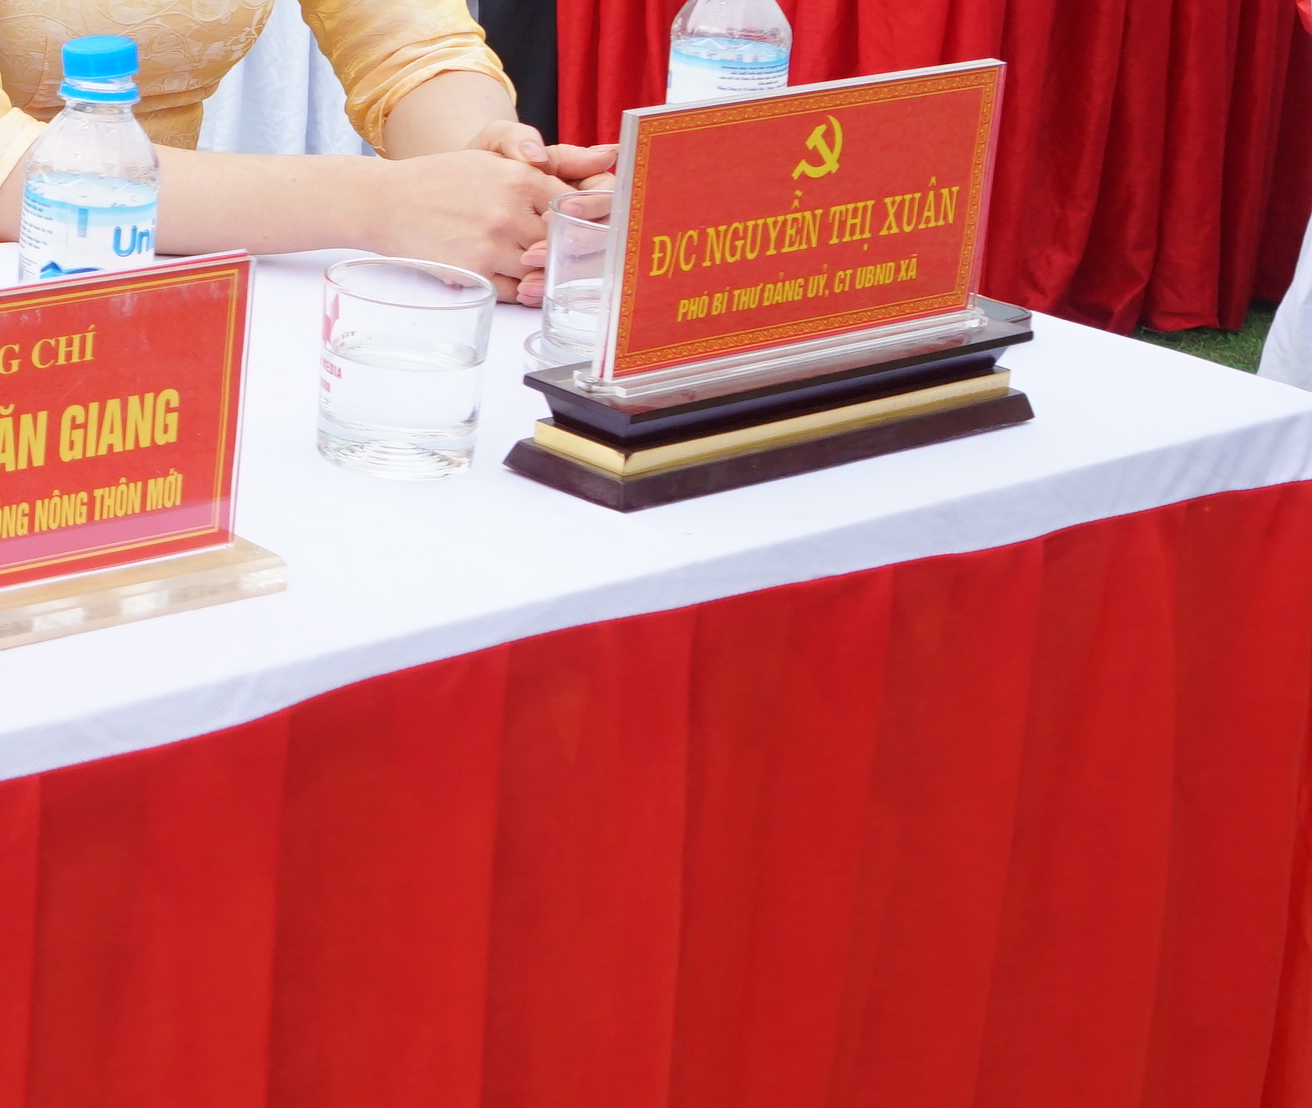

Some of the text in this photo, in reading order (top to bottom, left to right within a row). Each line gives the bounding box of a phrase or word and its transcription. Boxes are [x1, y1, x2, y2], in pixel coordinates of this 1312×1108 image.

[650, 176, 959, 278] Đ/C NGUYỄN THỊ XUÂN
[678, 289, 708, 322] PHÓ
[712, 286, 729, 316] BÍ
[732, 283, 763, 312] THƯ
[762, 272, 804, 307] ĐẢNG
[834, 271, 852, 293] CT
[855, 262, 895, 286] UBND
[897, 254, 918, 281] XÃ
[31, 325, 96, 368] CHÍ
[58, 389, 180, 462] GIANG
[34, 489, 87, 529] NÔNG
[93, 477, 141, 519] THÔN
[146, 470, 183, 511] MỚI
